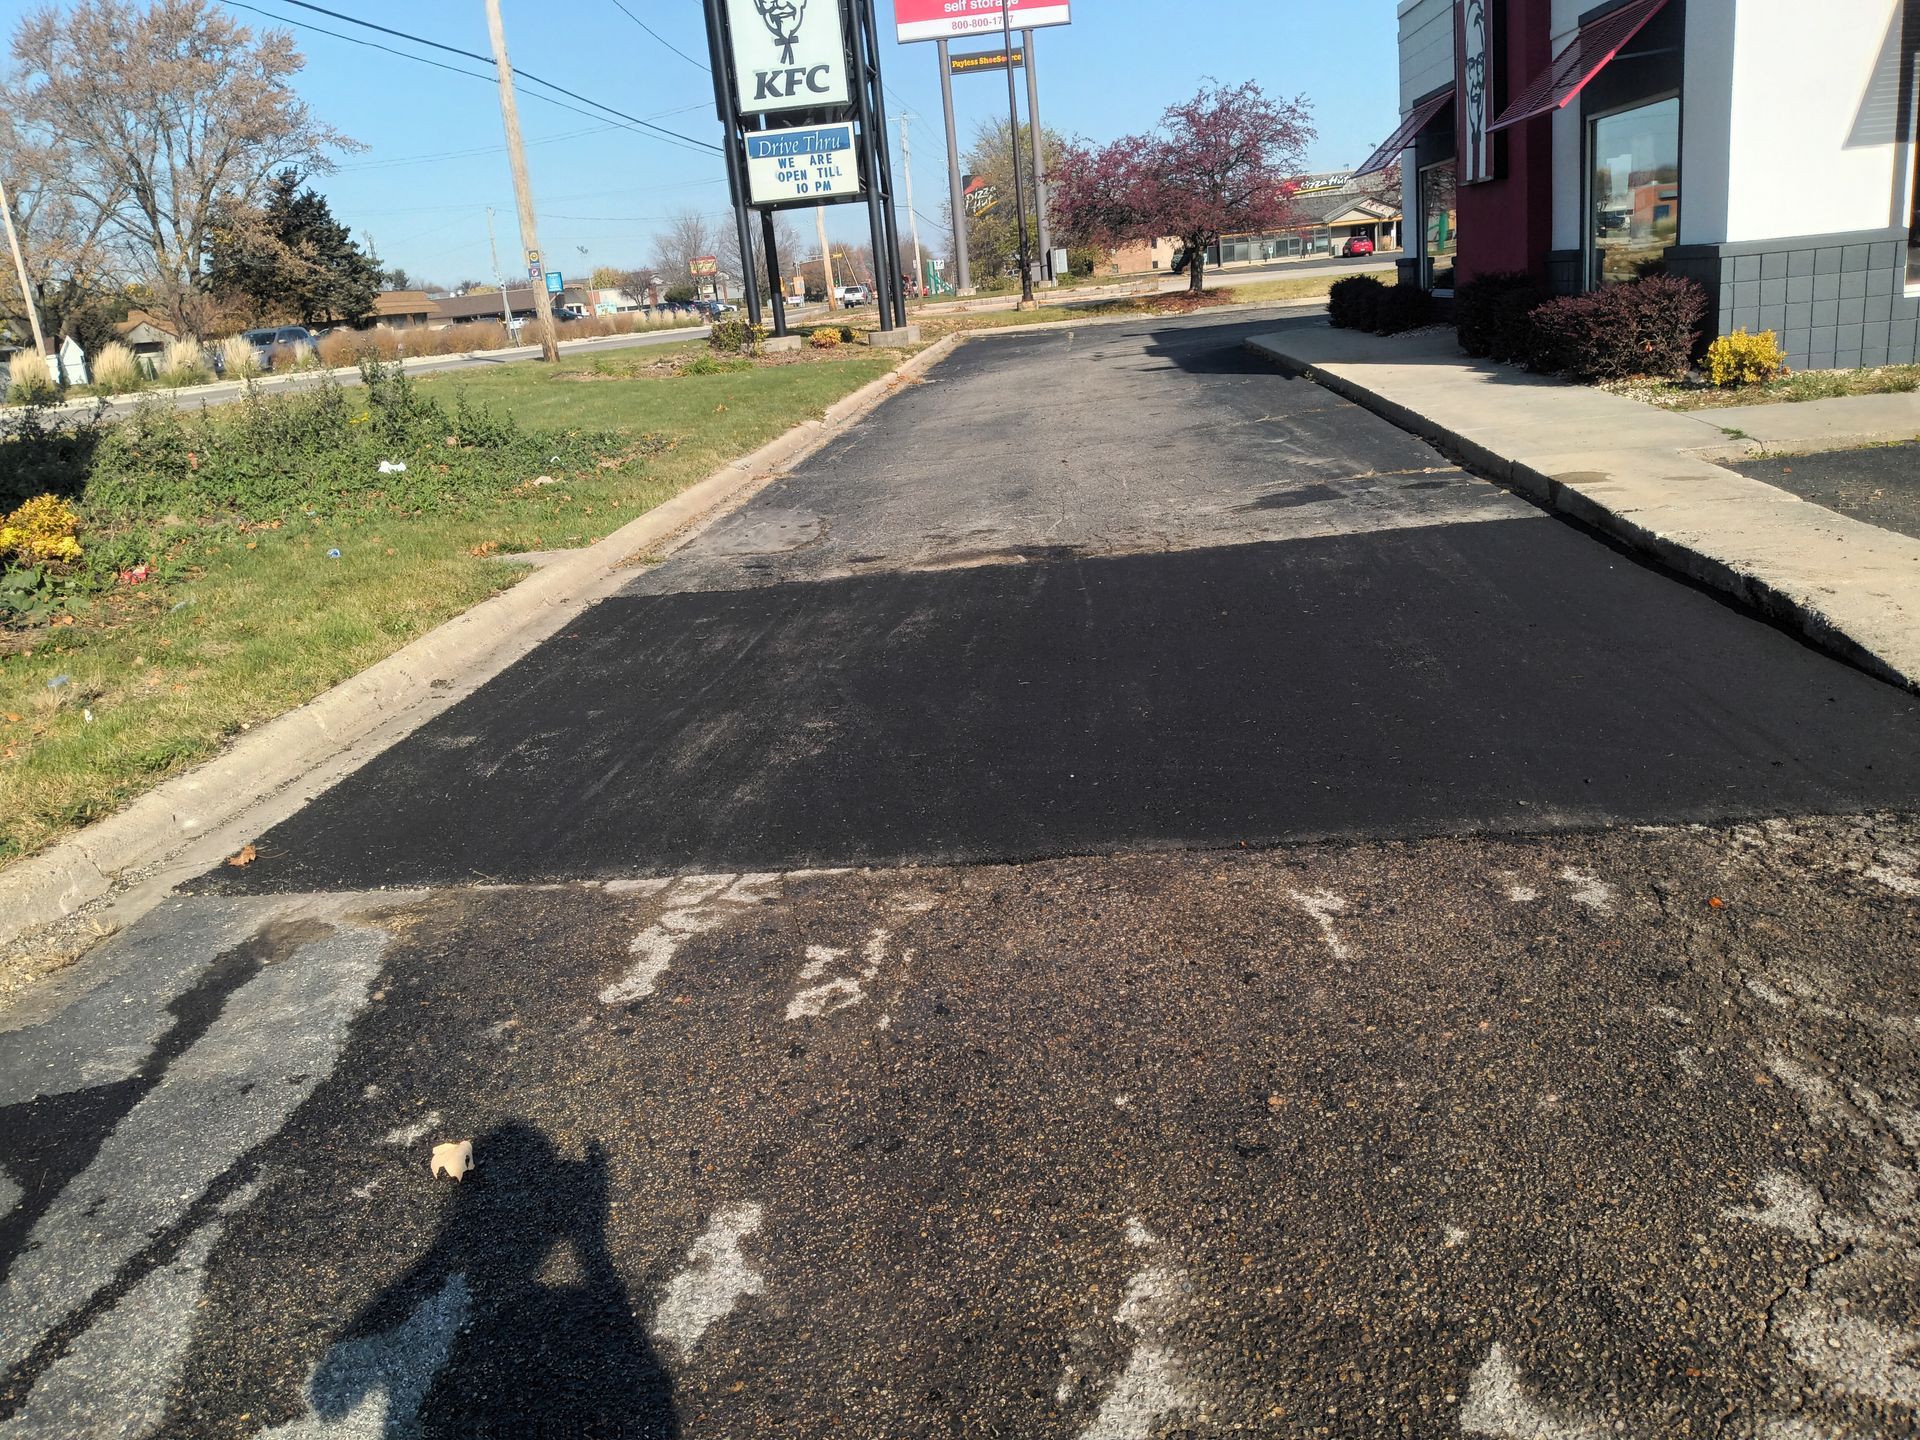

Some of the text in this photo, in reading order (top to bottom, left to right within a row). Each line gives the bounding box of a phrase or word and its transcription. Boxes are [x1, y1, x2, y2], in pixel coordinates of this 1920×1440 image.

[944, 1, 967, 13] self
[951, 15, 1014, 31] 800-800-177
[952, 59, 979, 69] Payless
[753, 64, 830, 101] KFC
[758, 131, 841, 157] Drive Thru
[777, 153, 833, 169] WE ARE
[777, 166, 843, 183] OPEN TILL
[815, 180, 832, 192] PM
